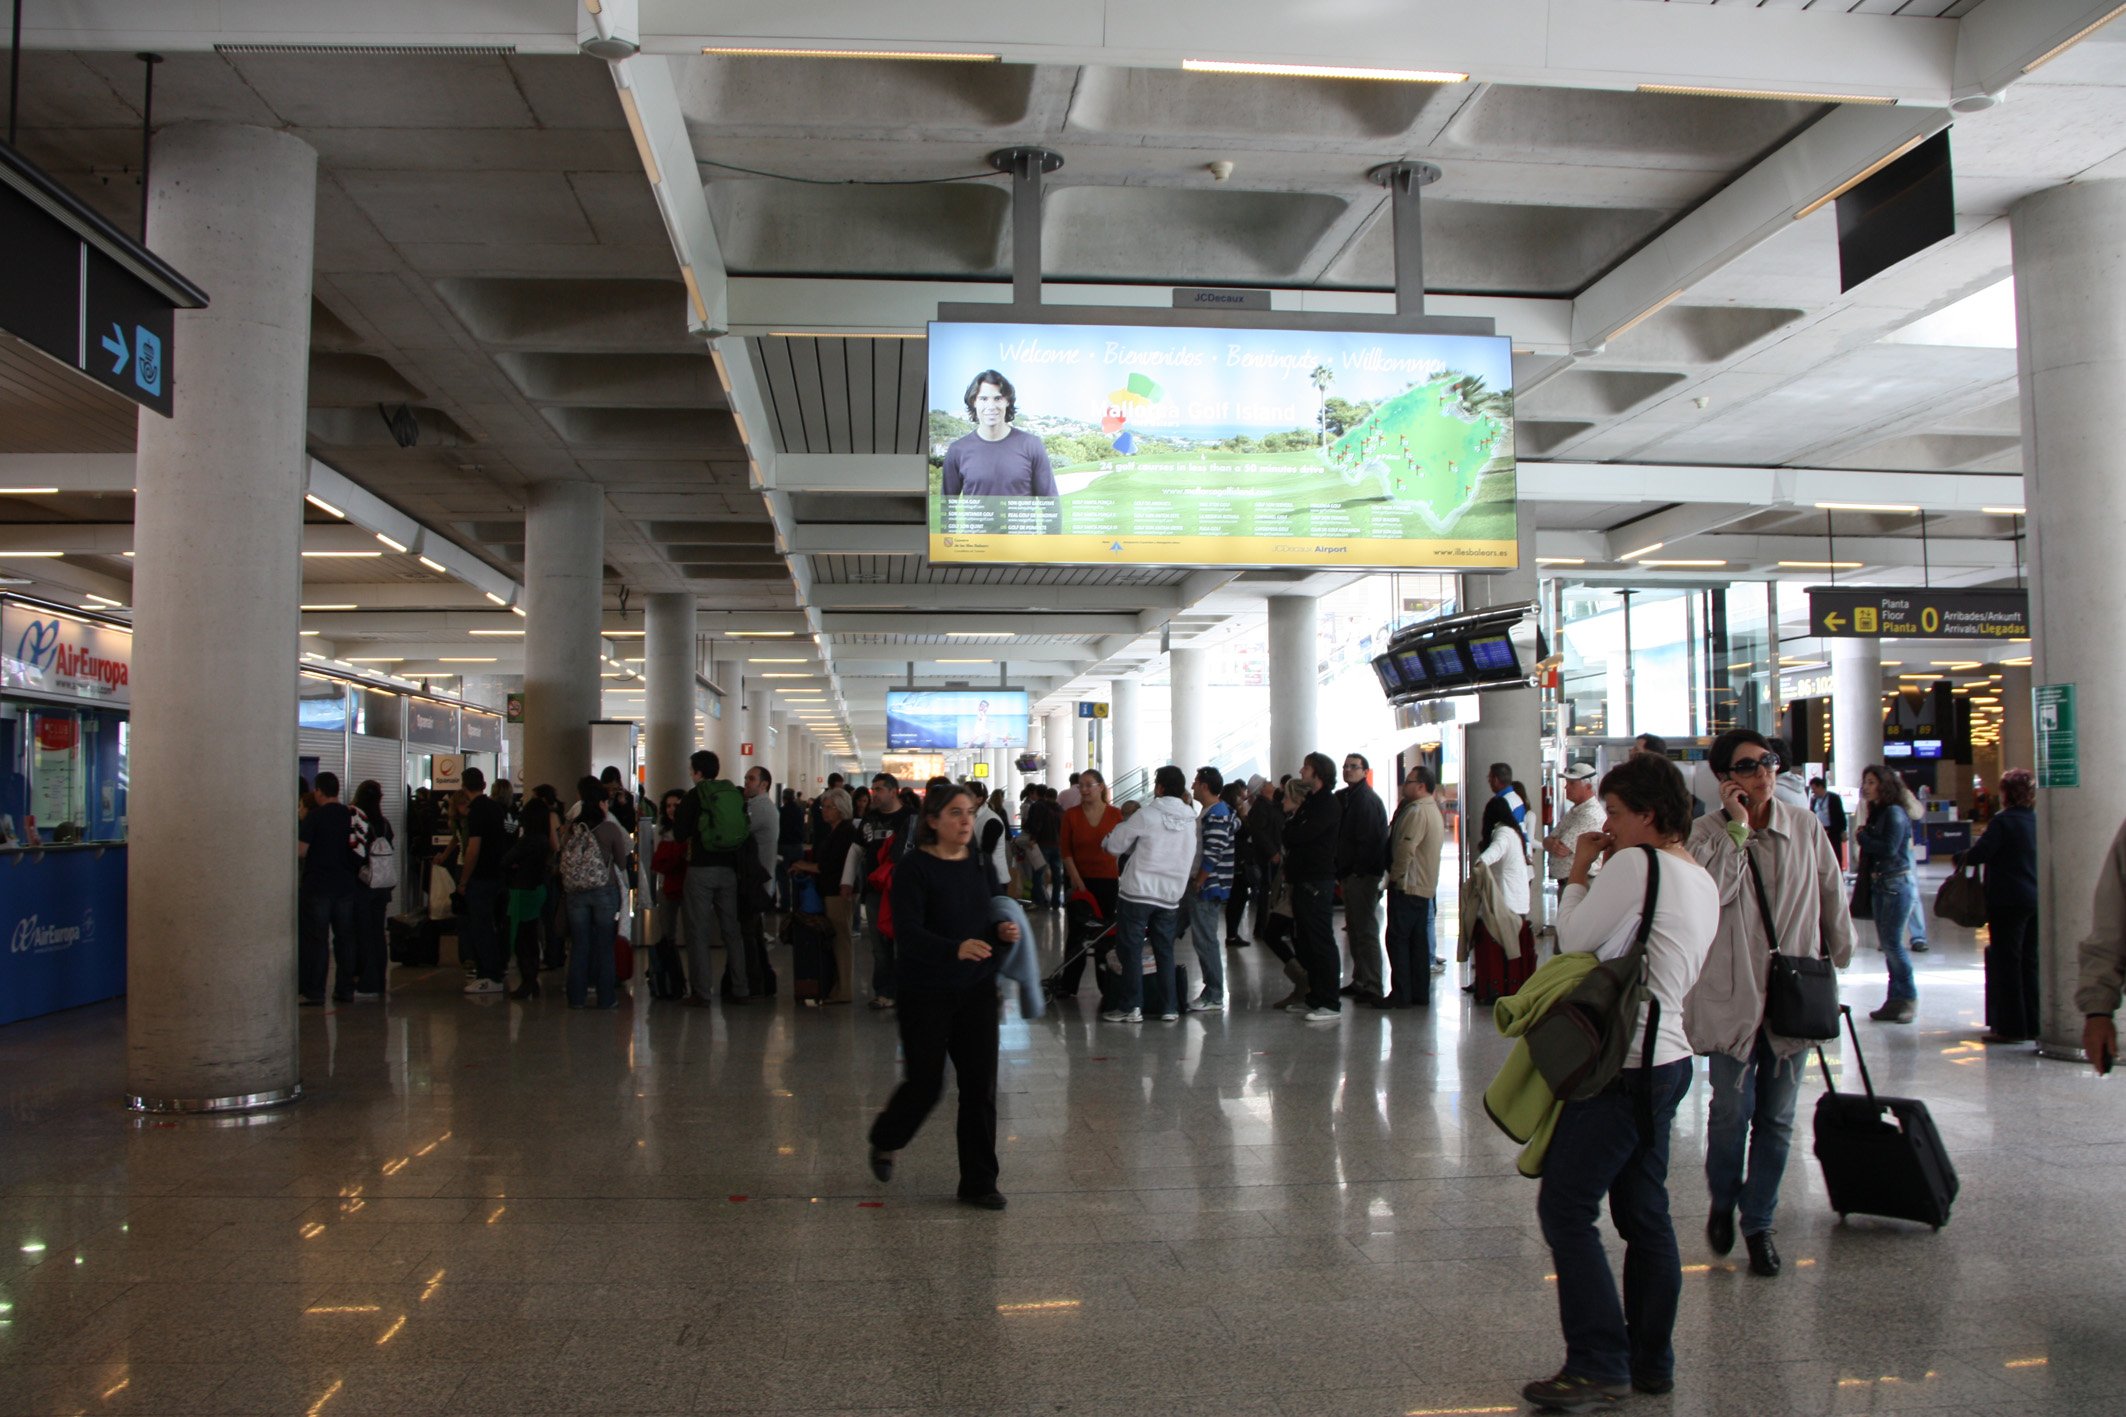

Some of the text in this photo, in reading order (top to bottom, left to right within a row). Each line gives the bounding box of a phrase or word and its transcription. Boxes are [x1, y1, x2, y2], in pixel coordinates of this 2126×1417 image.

[1194, 293, 1245, 303] JCDecaux
[999, 338, 1447, 380] Welcome Bienvenidos Benvinguts Willkommen
[1188, 401, 1230, 420] Golf
[1236, 402, 1296, 422] Island
[1116, 462, 1136, 473] golf
[1138, 464, 1174, 472] courses
[1177, 462, 1186, 472] in
[1189, 462, 1206, 473] less
[1210, 463, 1232, 473] than
[1260, 464, 1297, 474] minutes
[1300, 464, 1325, 474] drive
[1314, 545, 1347, 554] Airport
[1433, 548, 1508, 557] www.illesbalears.es
[1881, 599, 1909, 609] Planta
[1881, 611, 1905, 620] Floor
[1921, 606, 1939, 633] 0
[1944, 610, 2021, 622] Arribades/Ankunft
[1882, 622, 1917, 633] Planta
[1944, 623, 2026, 635] Arrivals/Llegadas
[56, 642, 129, 691] AirEuropa
[436, 777, 459, 786] Spanair
[34, 925, 80, 946] AirEuropa
